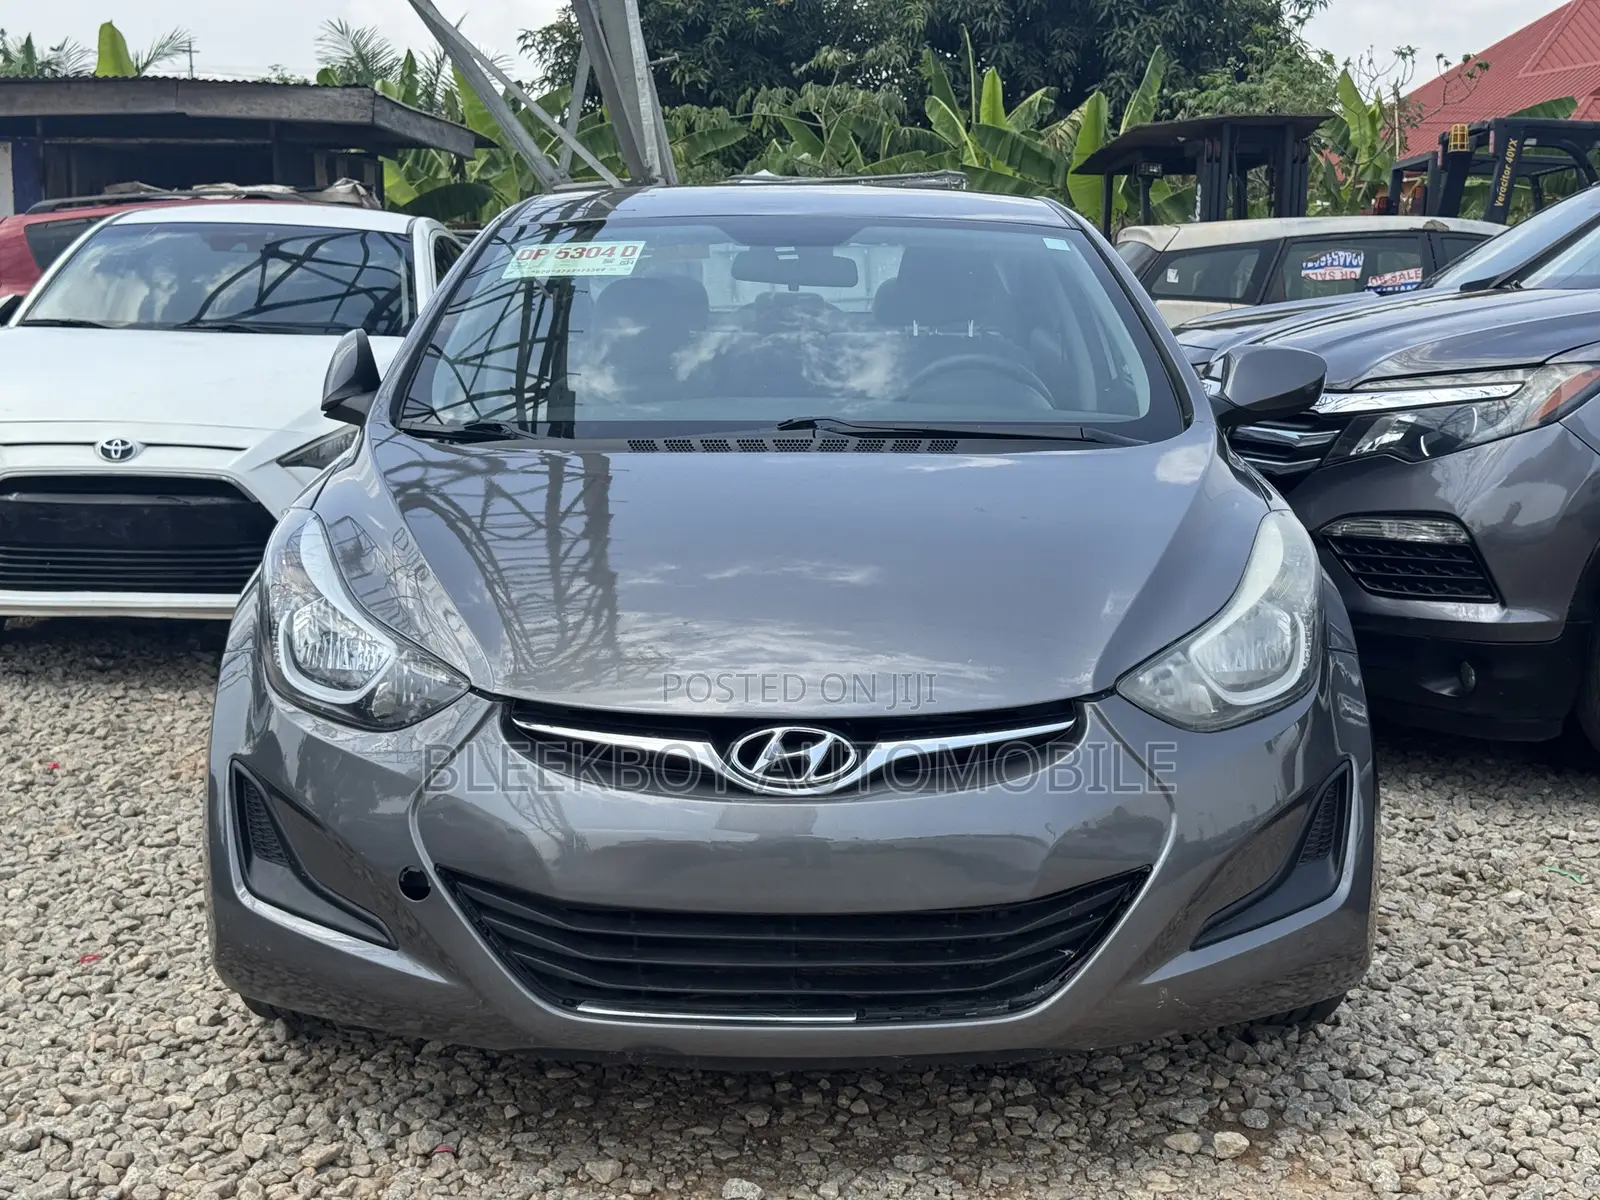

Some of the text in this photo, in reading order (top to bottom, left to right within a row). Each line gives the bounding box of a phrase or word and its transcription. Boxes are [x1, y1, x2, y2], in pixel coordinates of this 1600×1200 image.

[1494, 138, 1518, 207] Veracitor 40VX
[554, 245, 617, 260] 5304
[620, 245, 639, 258] D
